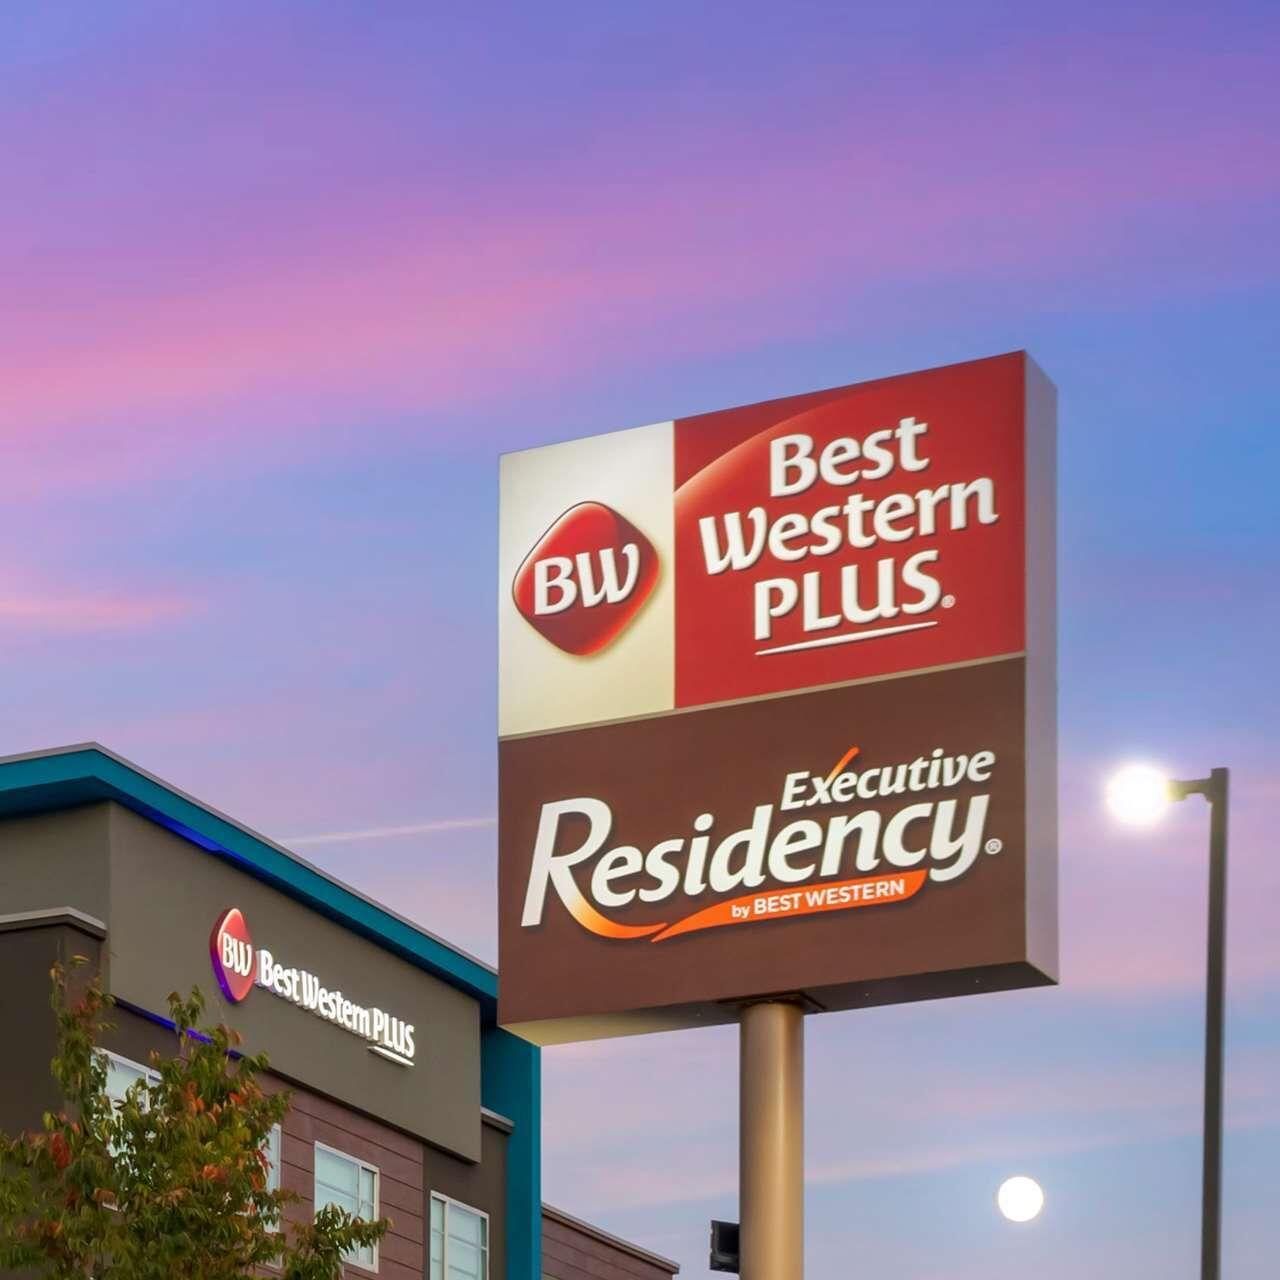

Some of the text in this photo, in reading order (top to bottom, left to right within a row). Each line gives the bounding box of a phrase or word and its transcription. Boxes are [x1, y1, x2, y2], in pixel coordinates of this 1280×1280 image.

[770, 416, 929, 498] Best
[698, 476, 1000, 576] Western
[533, 542, 640, 616] BW
[780, 746, 996, 812] Executive
[731, 879, 905, 918] by BEST WESTERN
[222, 932, 252, 977] BW
[260, 949, 415, 1058] Best Western PLUS
